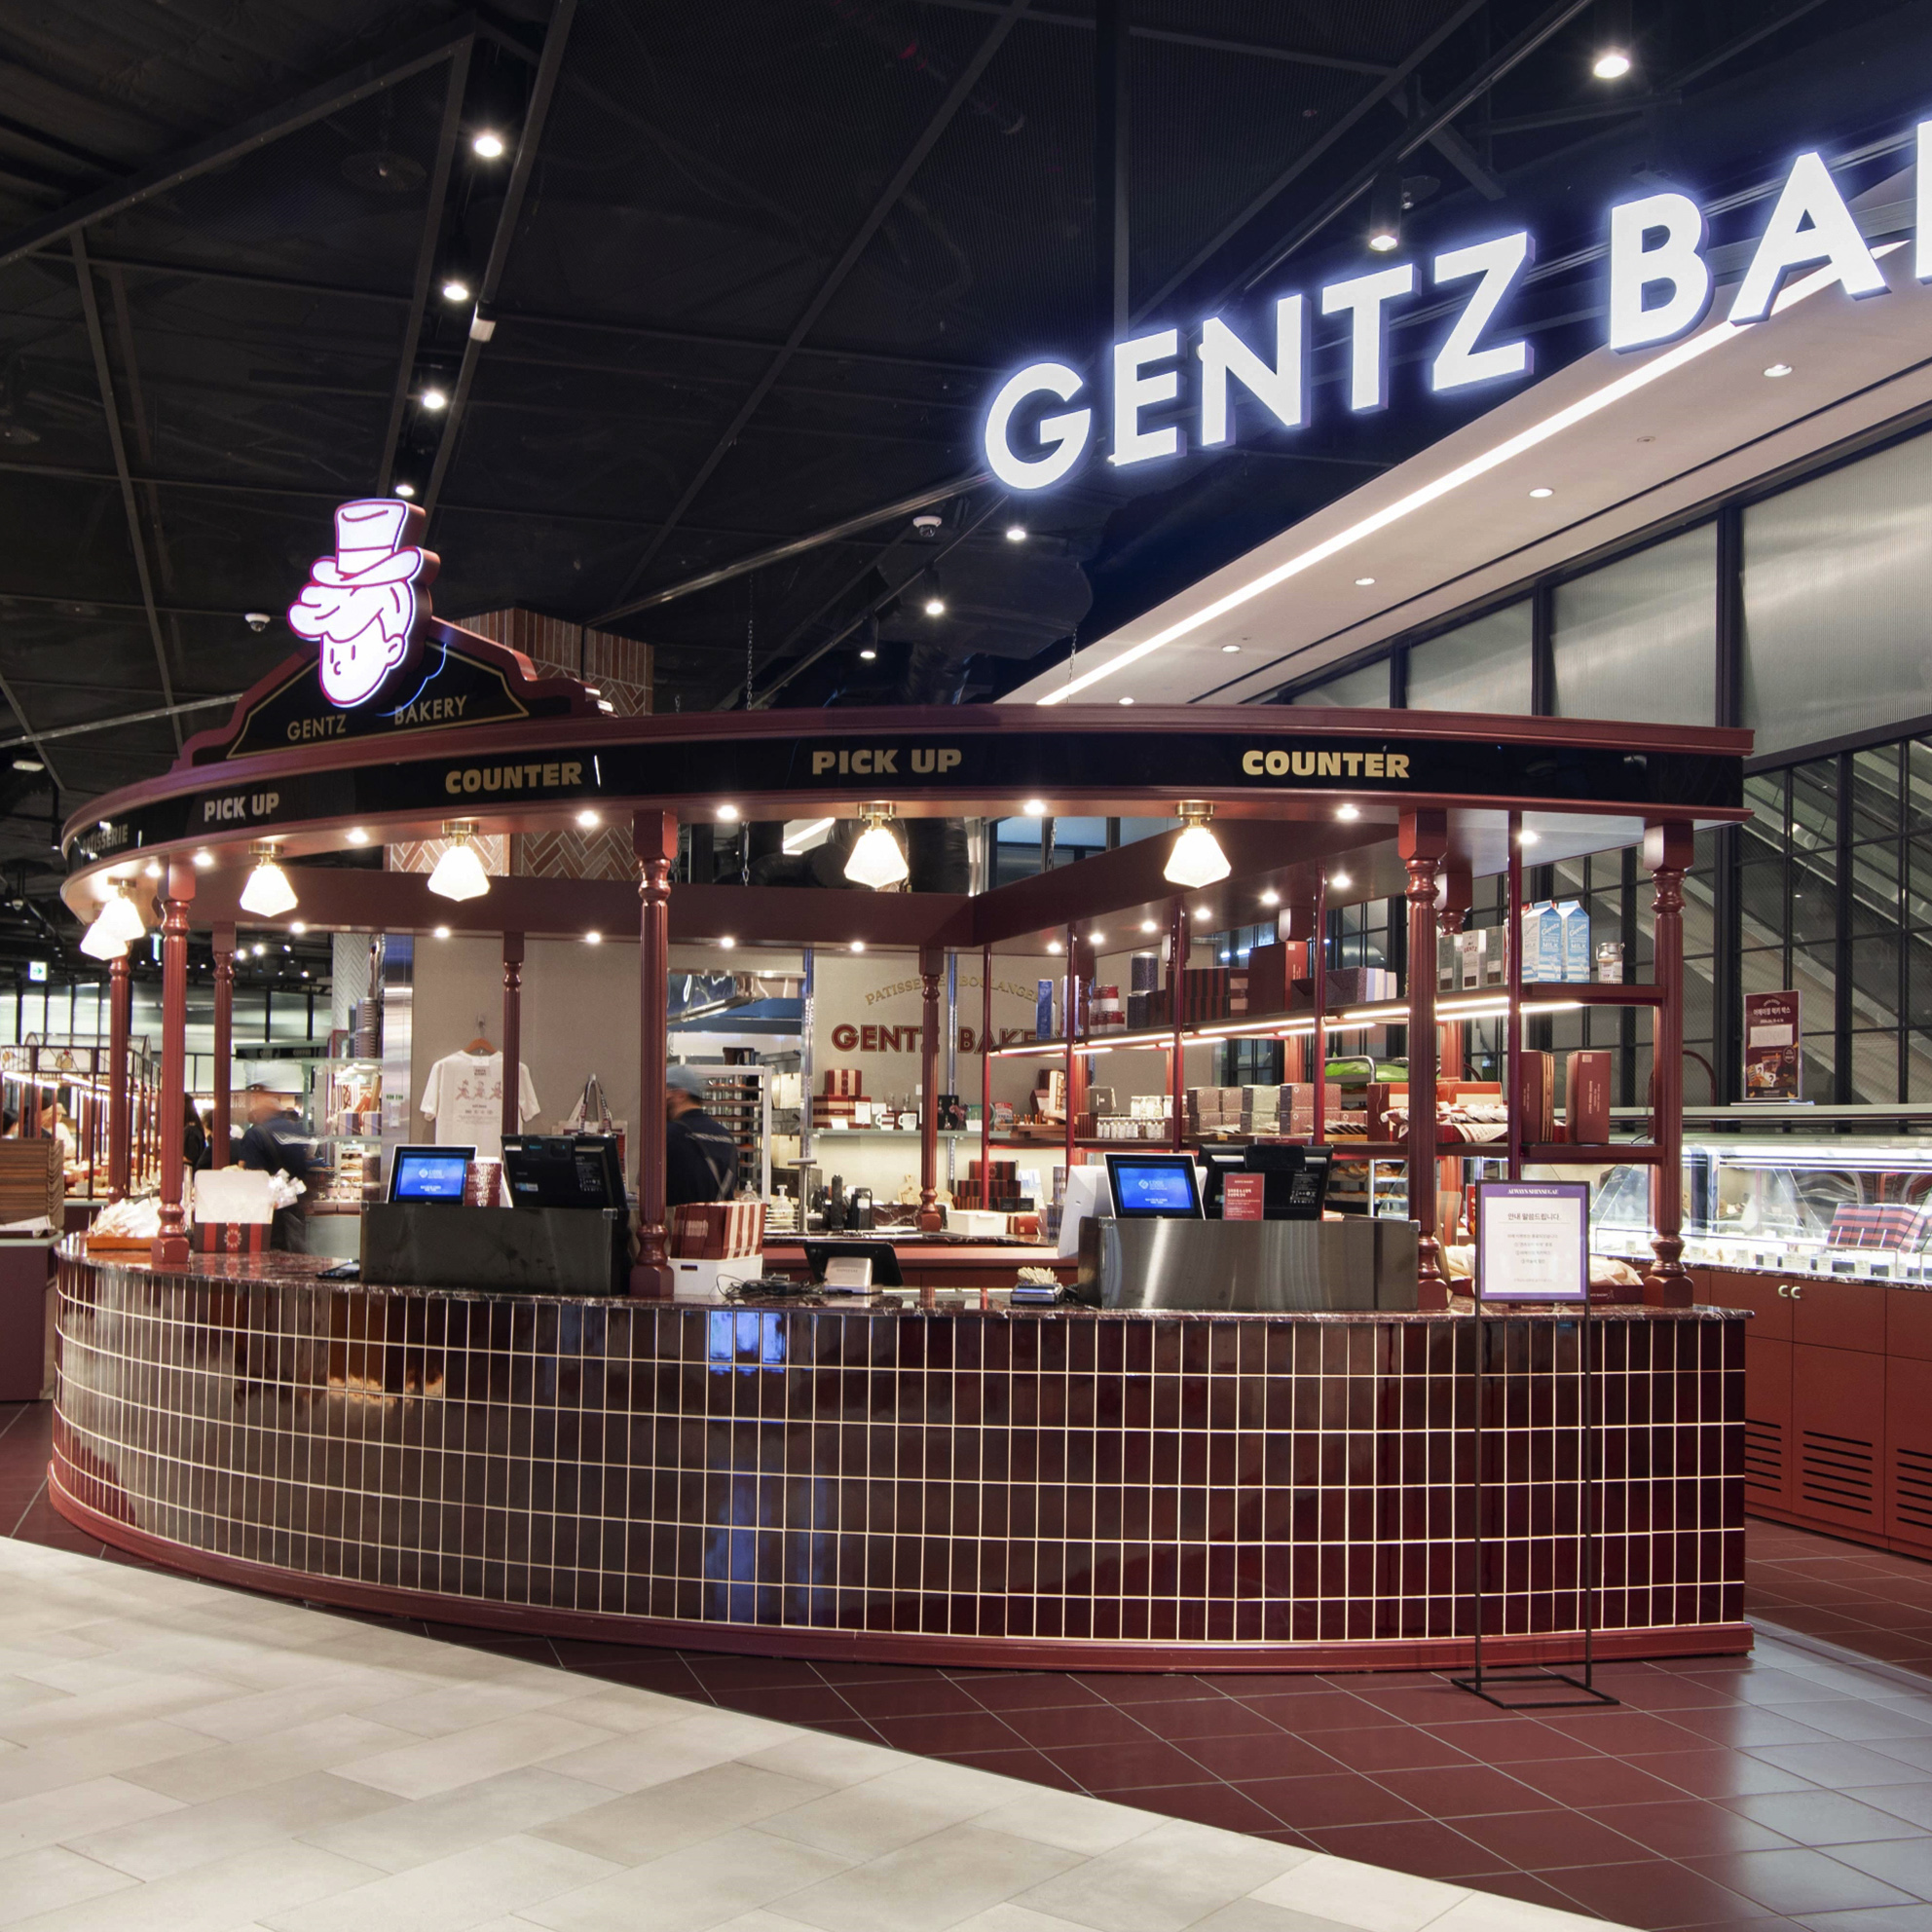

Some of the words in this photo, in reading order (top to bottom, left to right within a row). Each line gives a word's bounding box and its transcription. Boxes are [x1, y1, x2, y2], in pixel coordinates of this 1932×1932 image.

[983, 231, 1535, 492] GENTZ
[1609, 119, 1932, 353] BA
[287, 714, 347, 741] GENTZ
[393, 695, 467, 725] BAKERY
[812, 749, 898, 775] PICK
[910, 748, 962, 773] UP
[1242, 749, 1410, 778] COUNTER
[444, 762, 582, 794] COUNTER
[204, 796, 246, 822] PICK
[251, 792, 279, 816] UP
[832, 1023, 940, 1053] GENT
